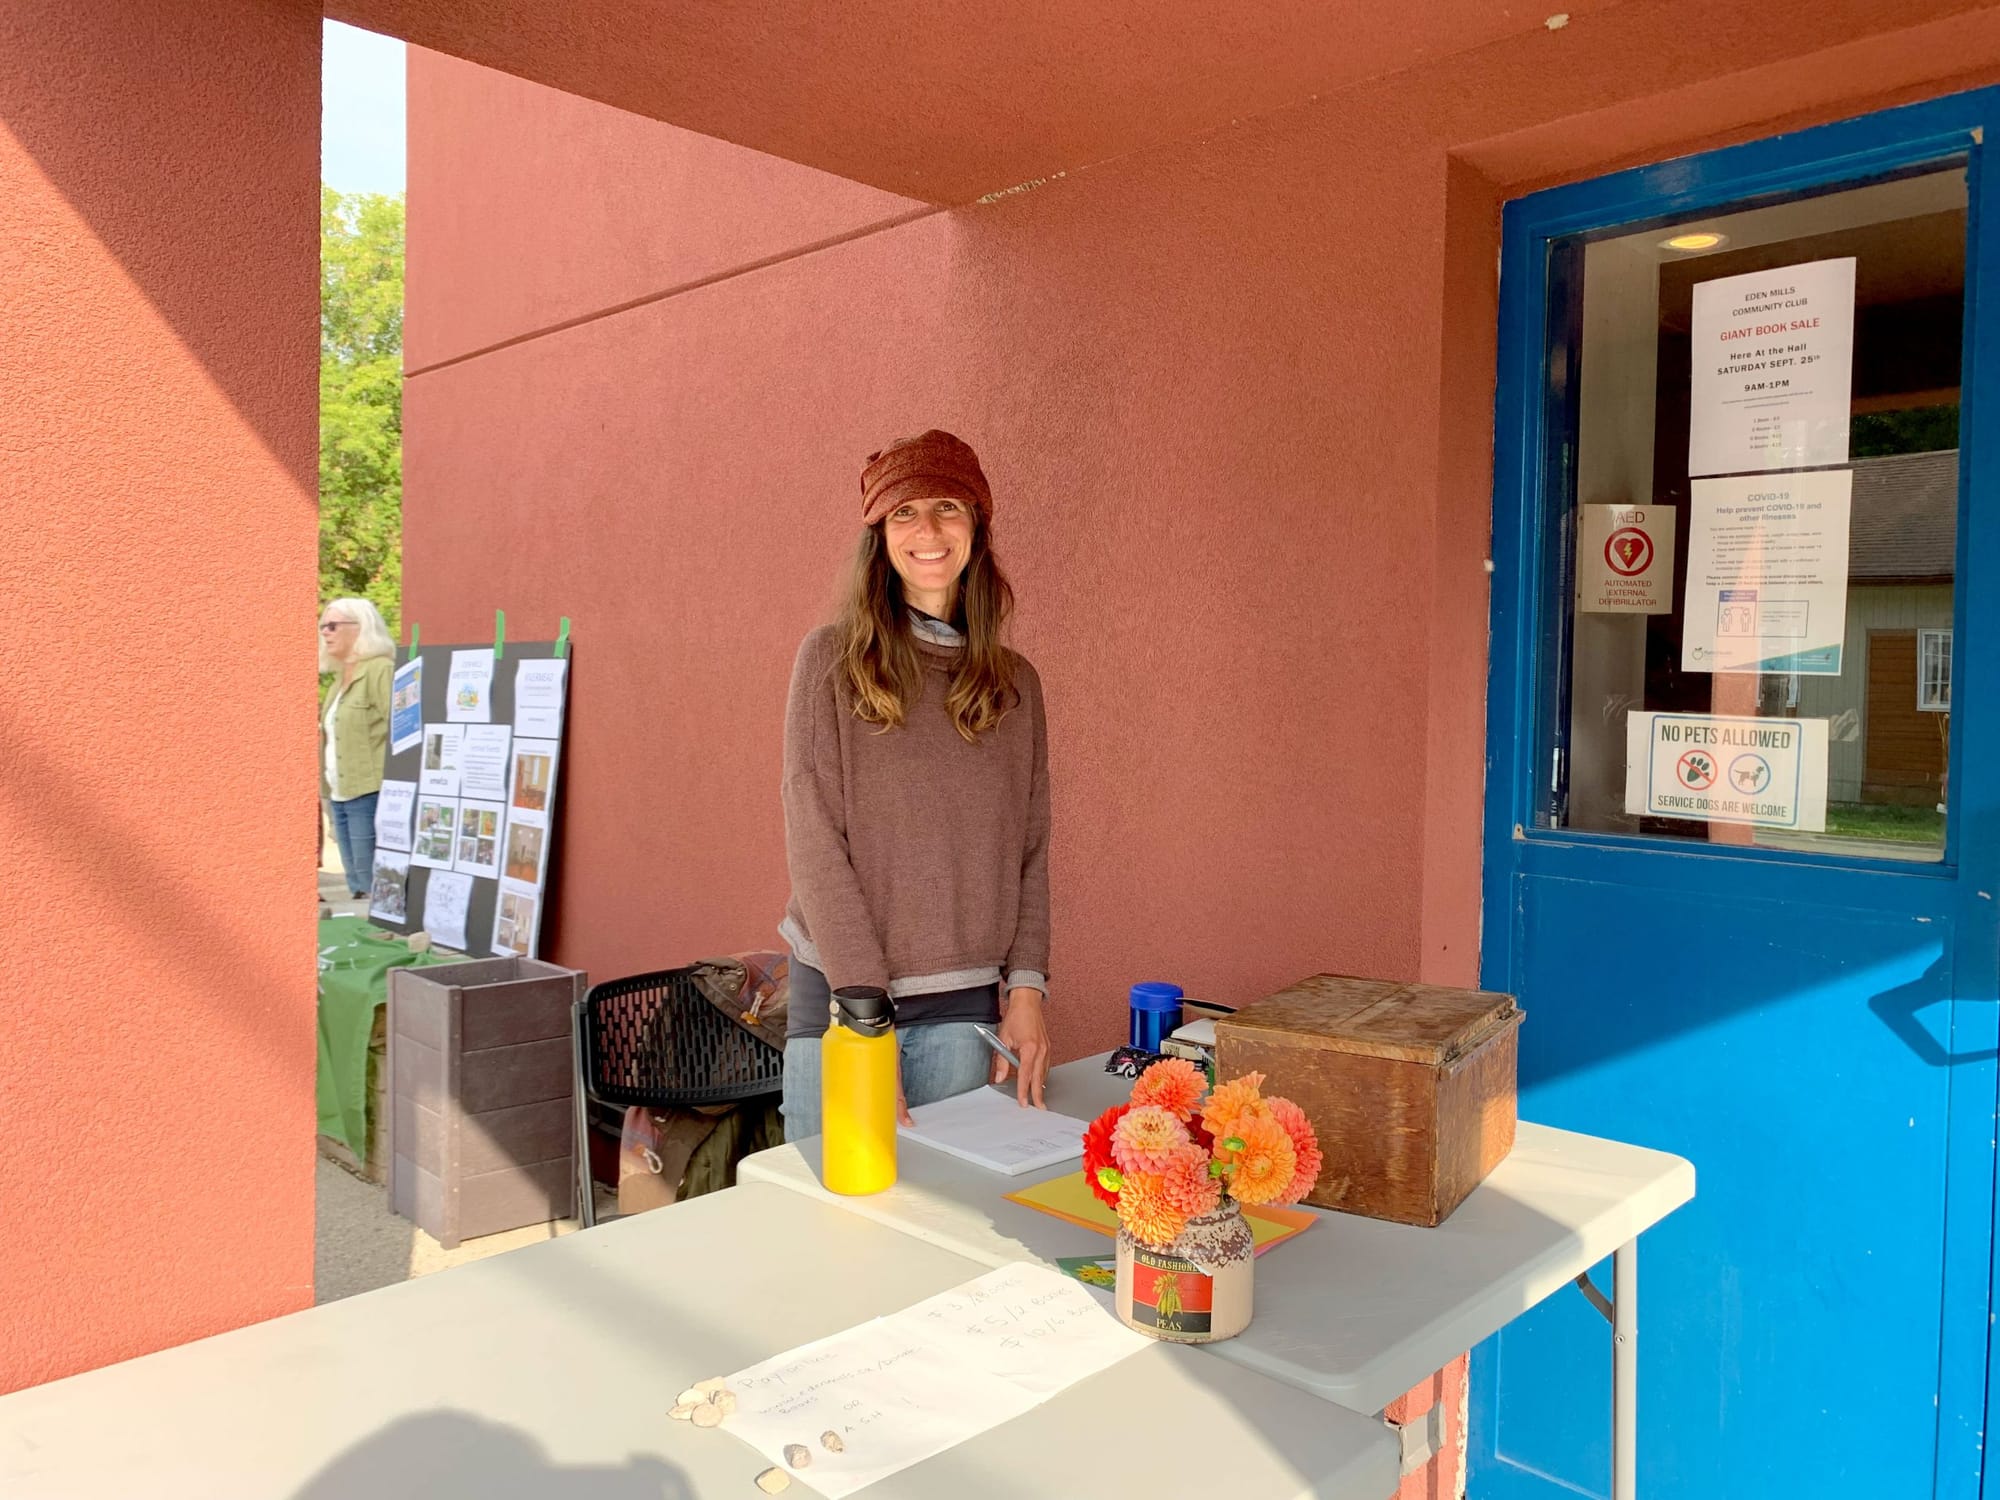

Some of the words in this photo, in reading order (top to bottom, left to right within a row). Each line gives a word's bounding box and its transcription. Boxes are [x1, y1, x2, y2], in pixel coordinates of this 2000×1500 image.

[1745, 291, 1768, 302] EDEN
[1769, 286, 1796, 297] MILLS
[1732, 302, 1784, 317] COMMUNITY
[1785, 298, 1808, 308] CLUB
[1720, 327, 1753, 341] GIANT
[1755, 323, 1788, 336] BOOK
[1790, 317, 1821, 330] SALE
[1730, 351, 1752, 360] Here
[1755, 349, 1765, 357] At
[1768, 347, 1784, 355] the
[1787, 343, 1807, 352] Hall
[1717, 362, 1767, 375] SATURDAY
[1769, 358, 1797, 368] SEPT.
[1744, 379, 1790, 392] 9AM-1PM
[1747, 492, 1790, 502] COVID-19
[1735, 506, 1764, 514] prevent
[1766, 503, 1805, 512] COVID-19
[1615, 511, 1645, 523] AED
[1739, 514, 1760, 522] other
[1761, 513, 1797, 521] illnesses
[1608, 589, 1648, 597] EXTERNAL
[1598, 598, 1657, 606] DEFIBRILLATOR
[1661, 724, 1680, 742] NO
[1684, 726, 1718, 744] PETS
[1722, 728, 1791, 749] ALLOWED
[1657, 795, 1696, 809] SERVICE
[1696, 799, 1720, 811] DOGS
[1721, 801, 1739, 813] ARE
[1742, 802, 1787, 818] WELCOME
[1141, 1254, 1156, 1266] OLD
[1157, 1258, 1199, 1272] FASHIONE
[1156, 1317, 1182, 1331] PEAS
[737, 1373, 786, 1388] Pay
